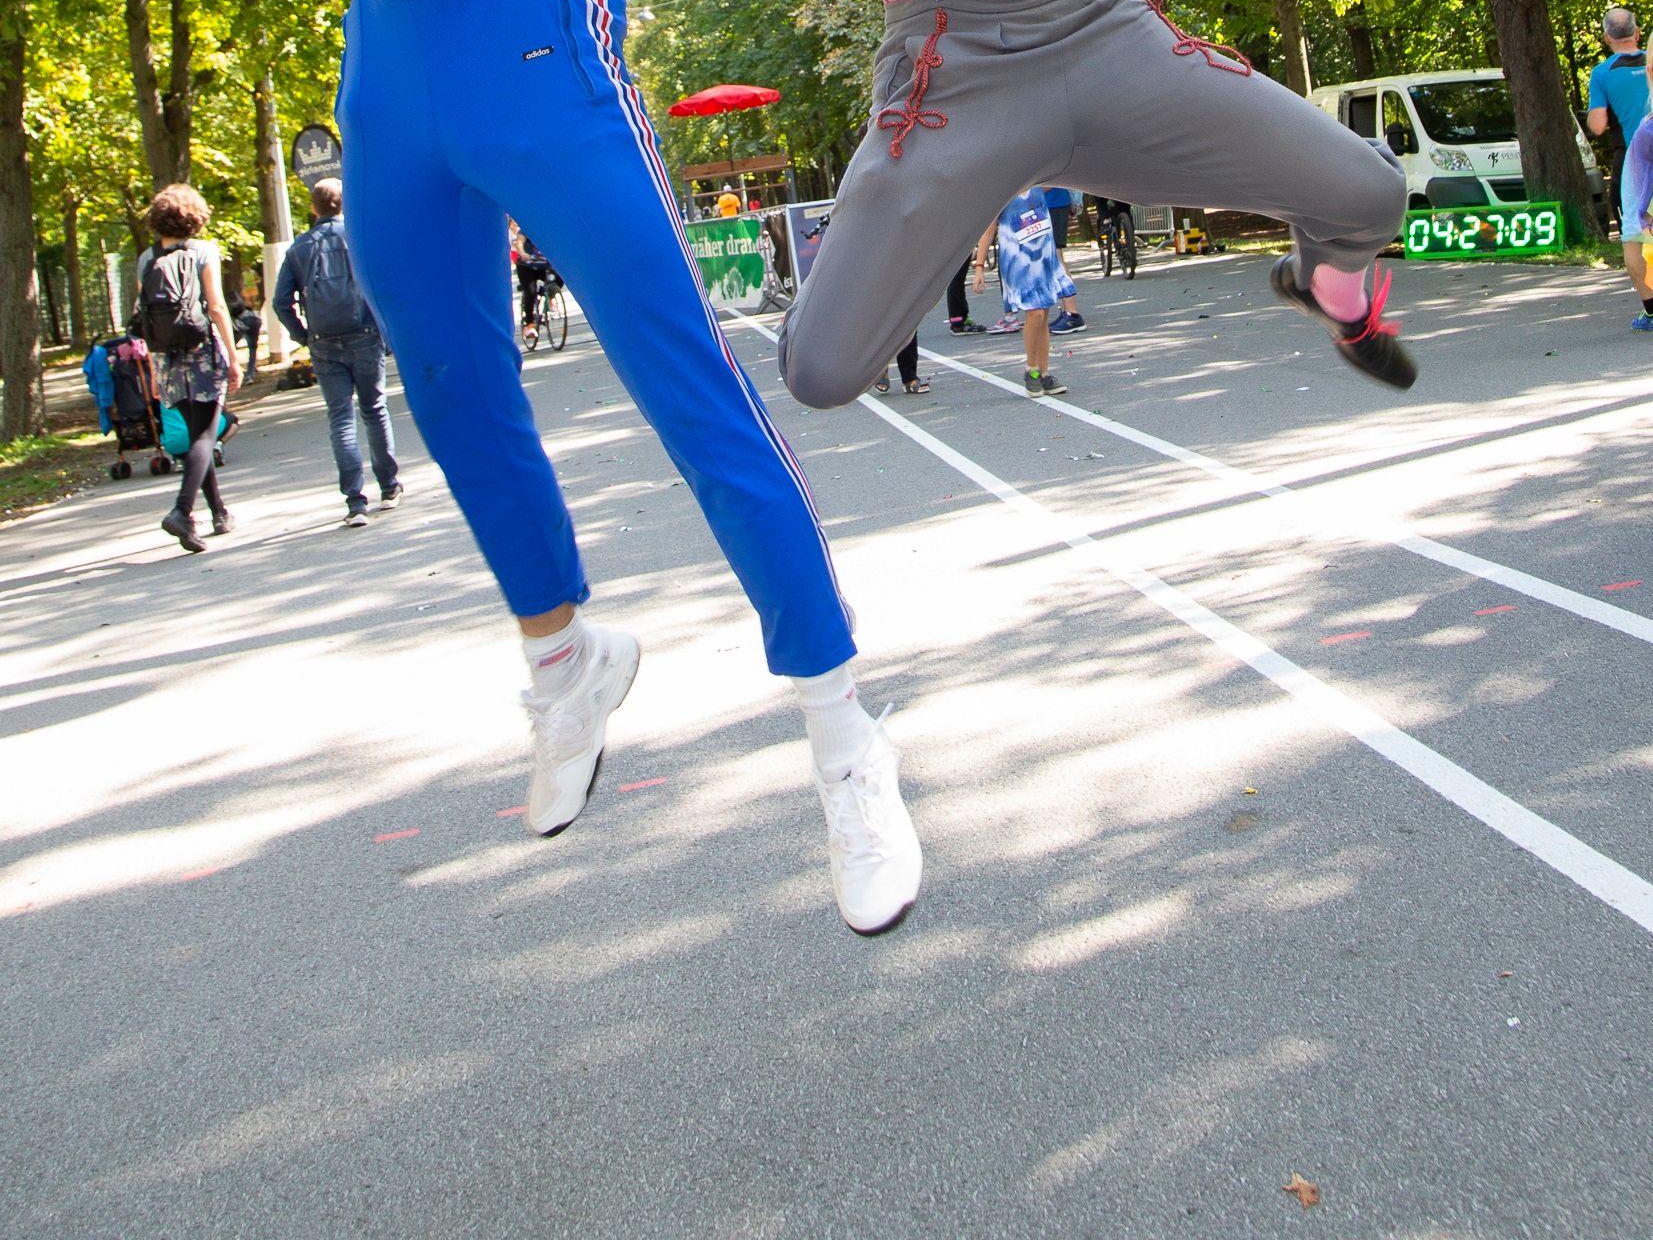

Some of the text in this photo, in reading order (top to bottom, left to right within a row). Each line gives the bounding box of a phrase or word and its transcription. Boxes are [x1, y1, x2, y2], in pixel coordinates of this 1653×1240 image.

[526, 48, 550, 60] adidas
[1408, 211, 1557, 252] 04:27:09
[691, 237, 724, 258] näher
